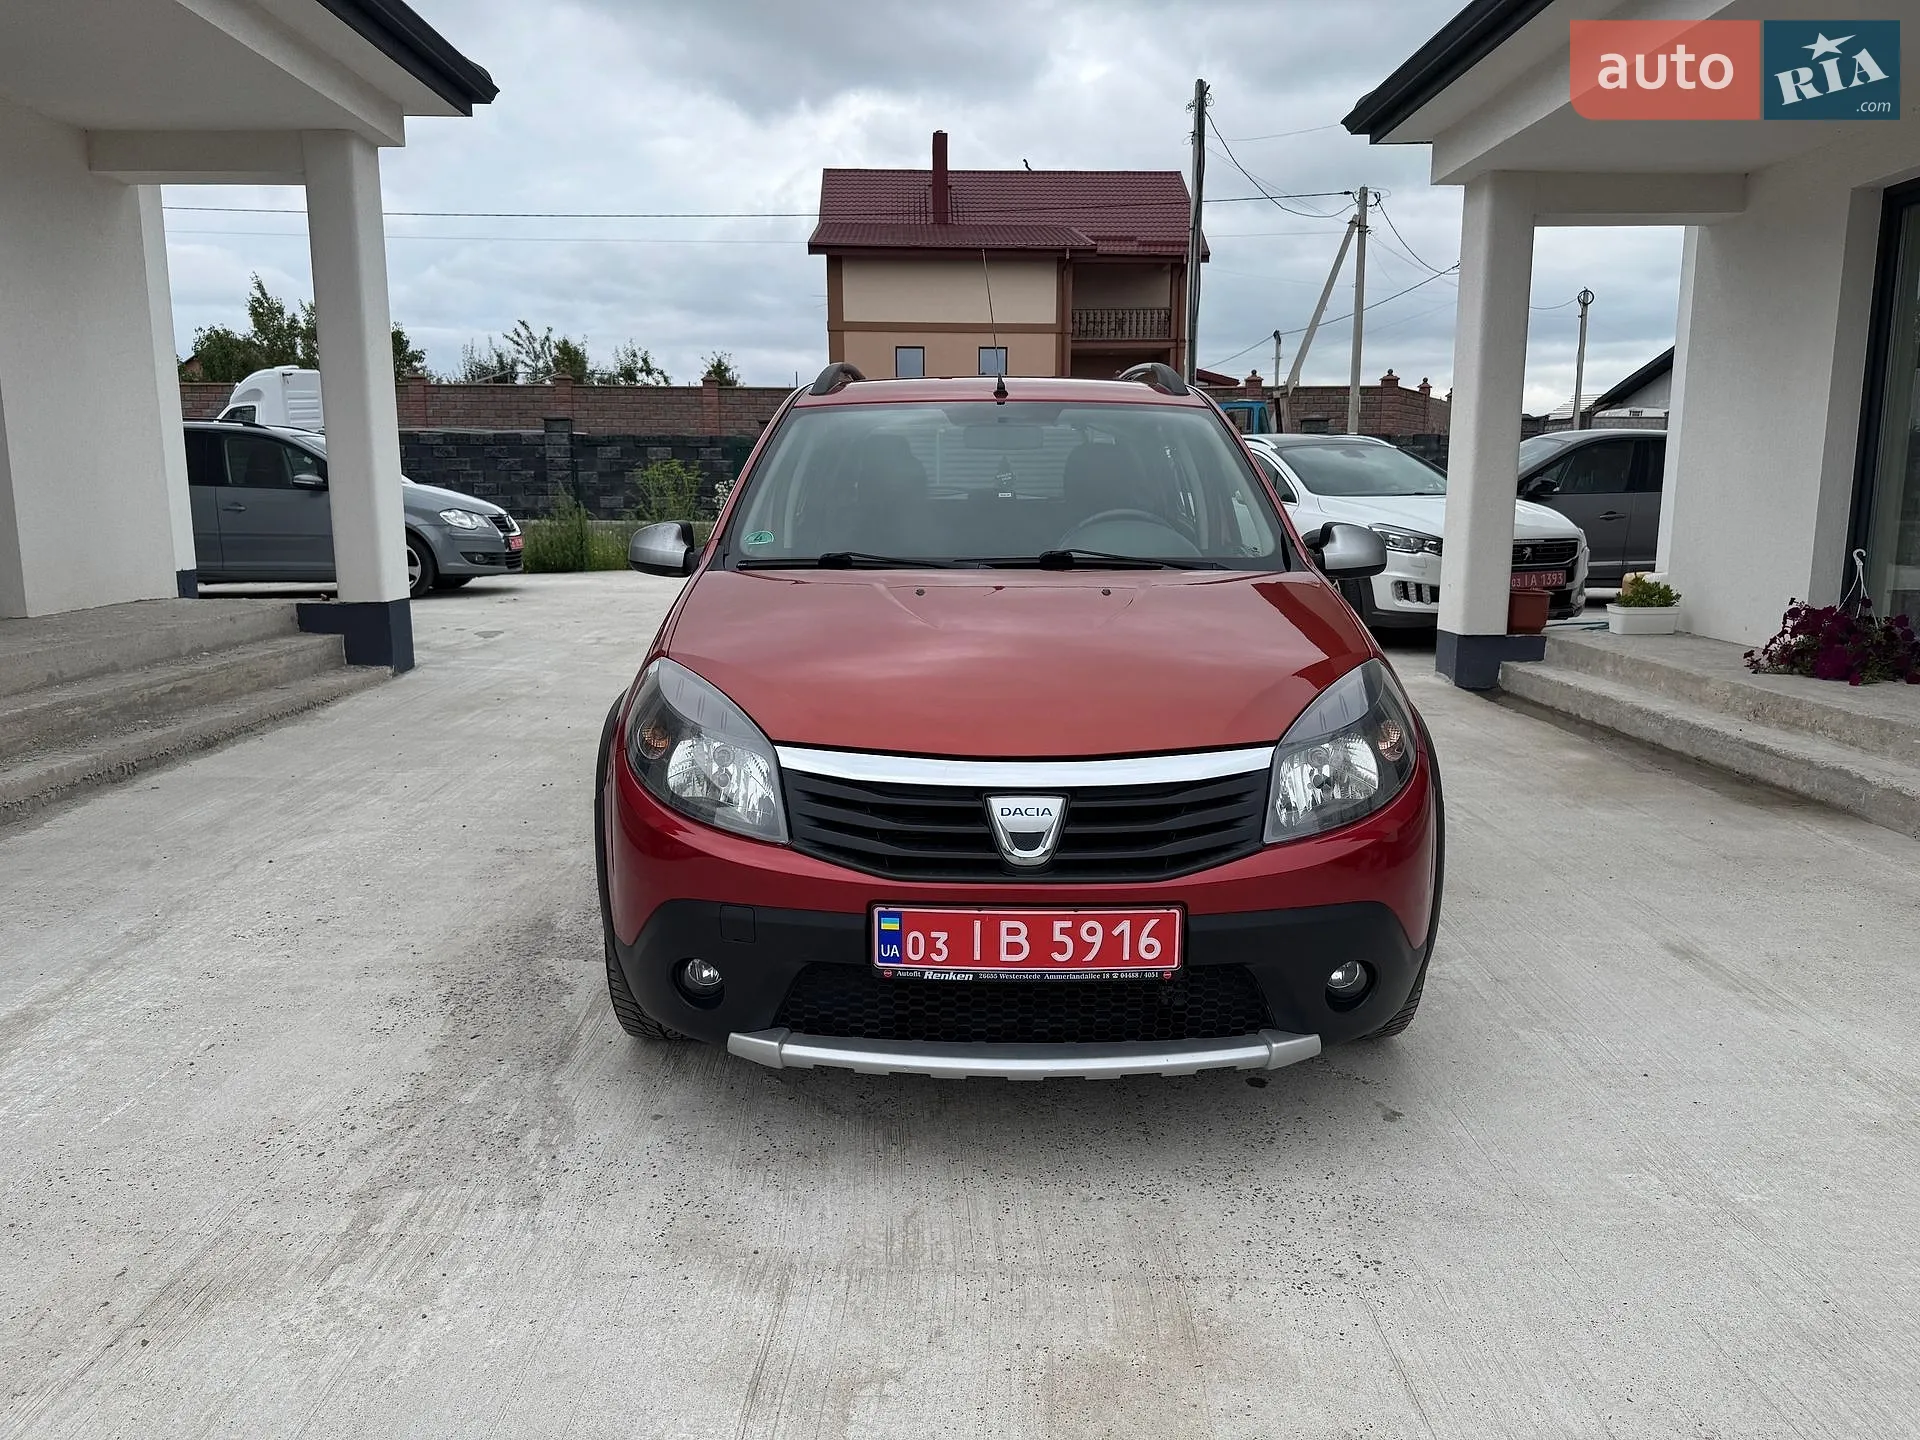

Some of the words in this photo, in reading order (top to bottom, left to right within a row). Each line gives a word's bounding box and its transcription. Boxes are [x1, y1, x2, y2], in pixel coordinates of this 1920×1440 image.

[1541, 572, 1564, 587] 1393
[1000, 807, 1053, 817] DACIA
[881, 944, 900, 958] UA
[906, 931, 949, 962] 03
[973, 920, 1031, 962] IB
[1050, 918, 1163, 962] 5916
[923, 971, 974, 981] Renken
